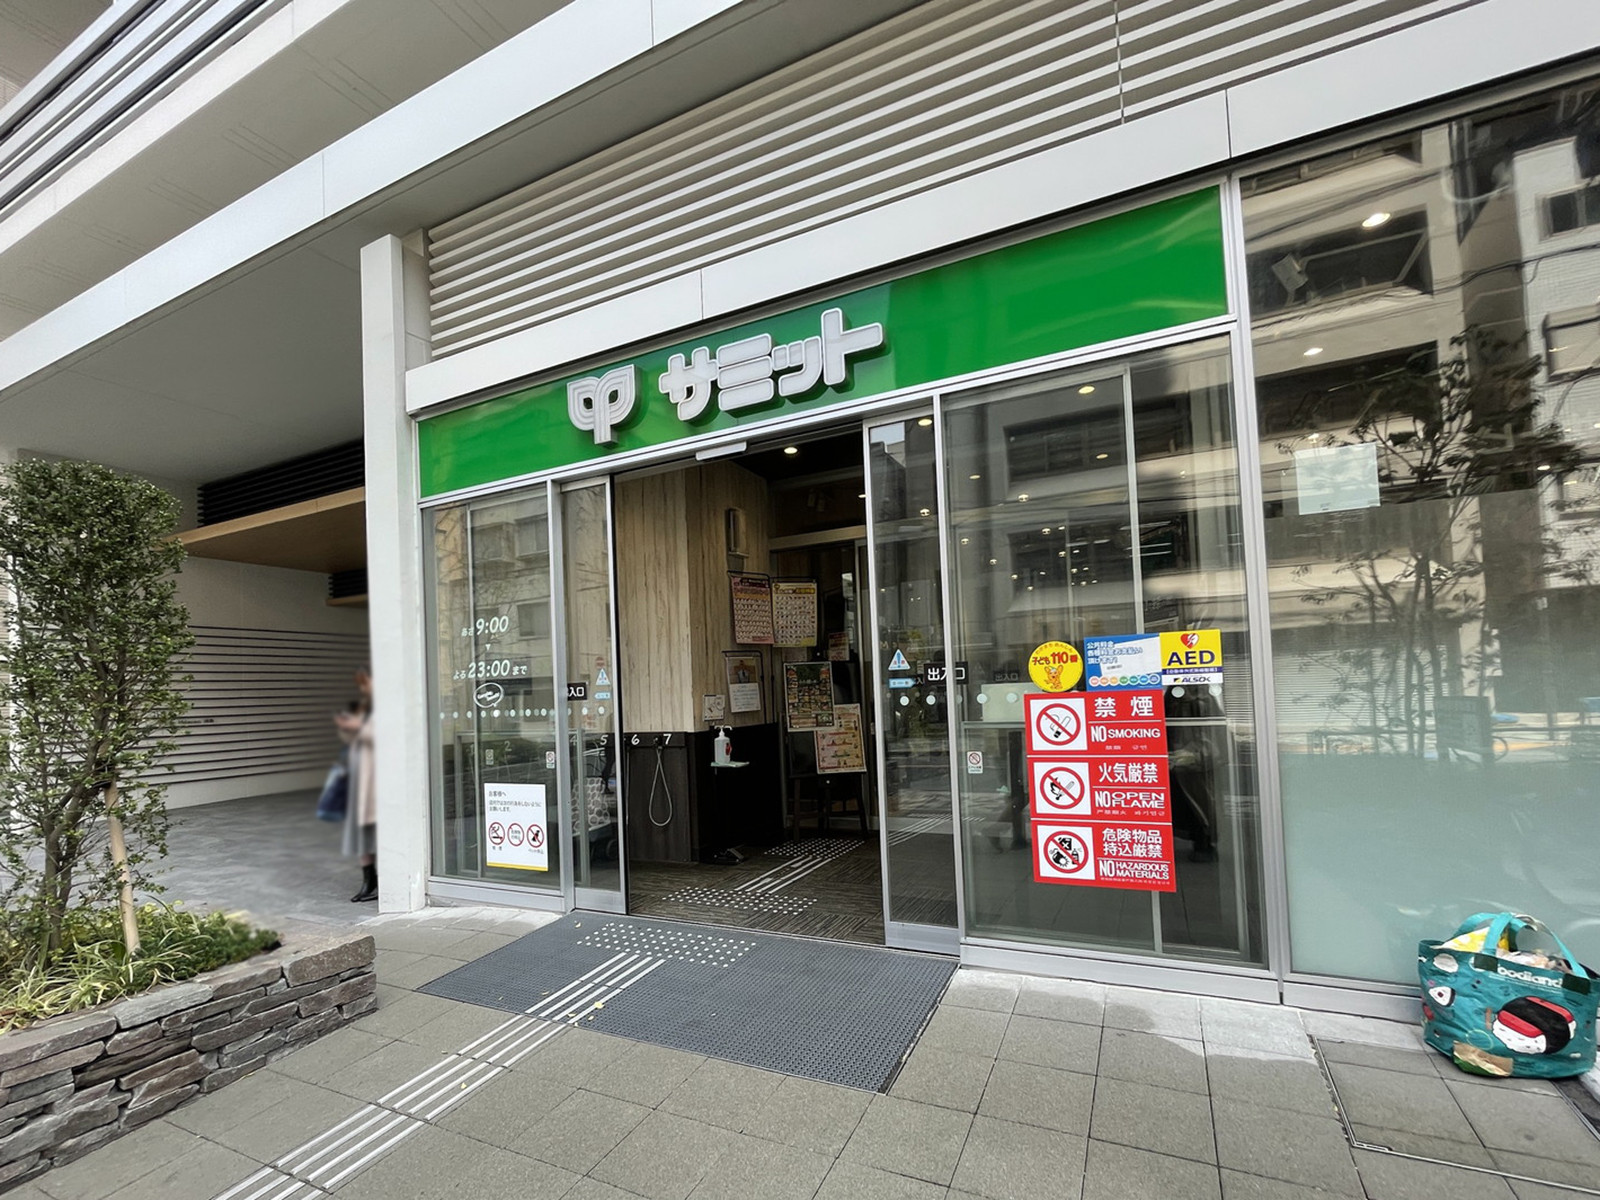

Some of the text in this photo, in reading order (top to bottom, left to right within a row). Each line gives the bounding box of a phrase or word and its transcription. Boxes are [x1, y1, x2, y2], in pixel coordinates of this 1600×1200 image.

[658, 307, 884, 422] サミット
[1167, 650, 1216, 666] AED
[567, 686, 585, 697] 入口
[600, 734, 609, 746] 5
[631, 733, 640, 746] 6
[663, 733, 672, 745] 7
[1090, 725, 1161, 742] NO SMOKING
[1098, 762, 1158, 783] 火気厳禁
[1094, 790, 1164, 808] NO OPEN
[1112, 800, 1165, 808] FLAME
[1102, 827, 1162, 844] 危険物品
[1103, 841, 1162, 858] 持込厳禁
[1099, 860, 1168, 877] NO HAZARDOUS
[1117, 870, 1169, 879] MATERIALS
